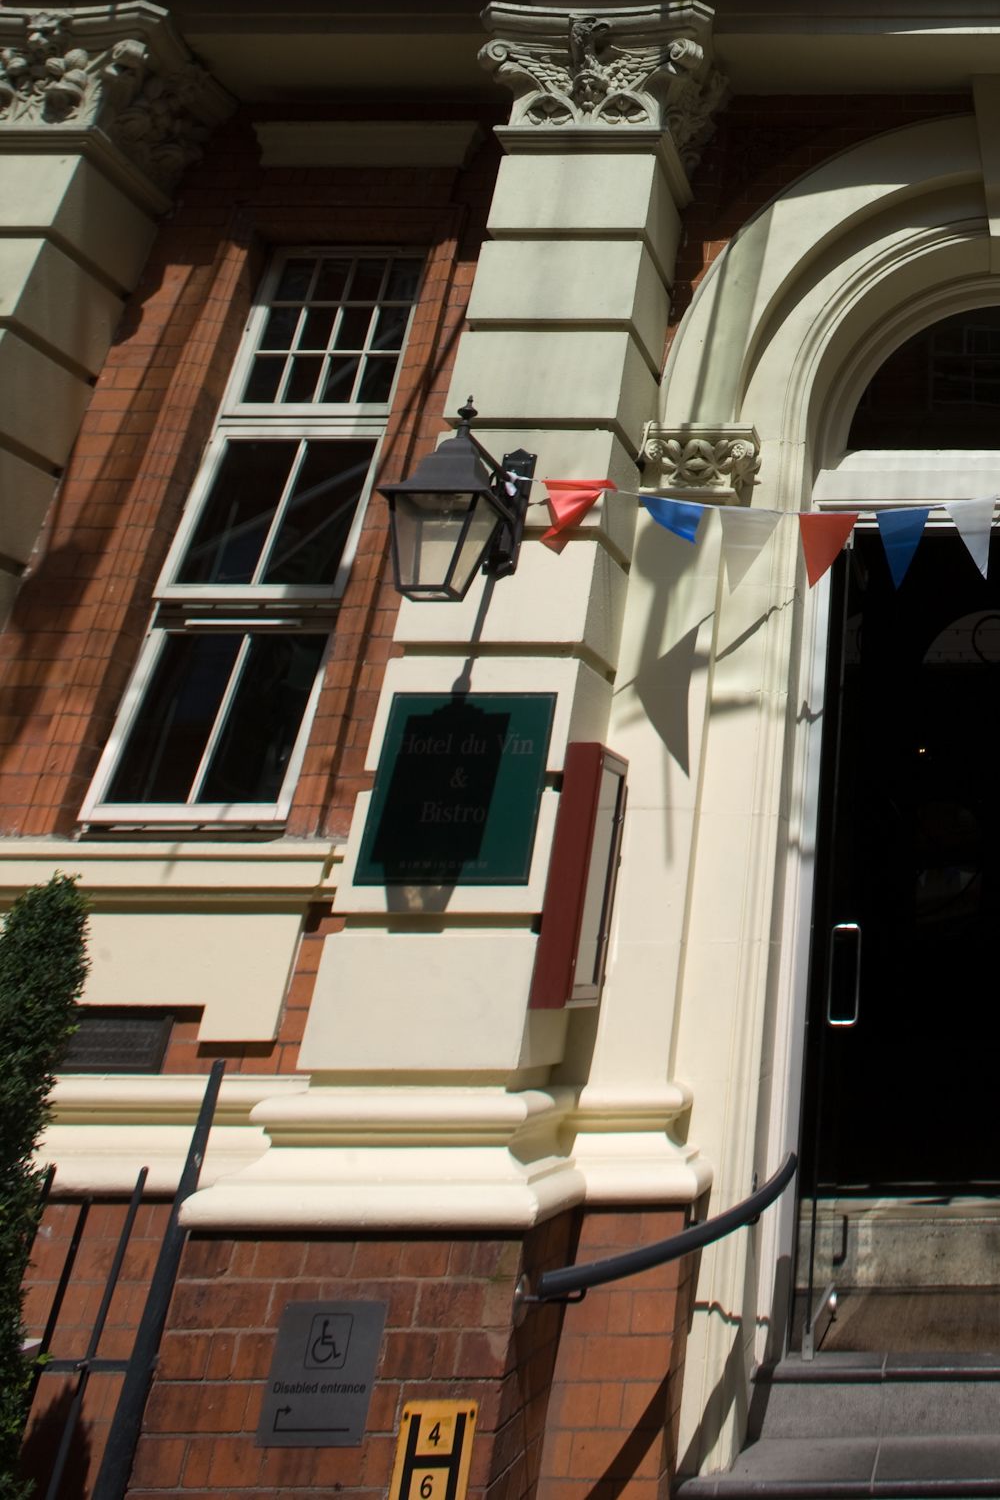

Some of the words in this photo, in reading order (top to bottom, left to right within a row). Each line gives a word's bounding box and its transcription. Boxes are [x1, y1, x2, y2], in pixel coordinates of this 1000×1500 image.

[397, 733, 453, 755] Hotel
[460, 733, 488, 755] du
[497, 732, 535, 755] Vin
[449, 765, 469, 788] &
[419, 801, 488, 823] Bistro
[272, 1381, 319, 1394] Disabled
[320, 1382, 366, 1394] entrance
[428, 1421, 441, 1446] 4
[420, 1474, 434, 1499] 6
